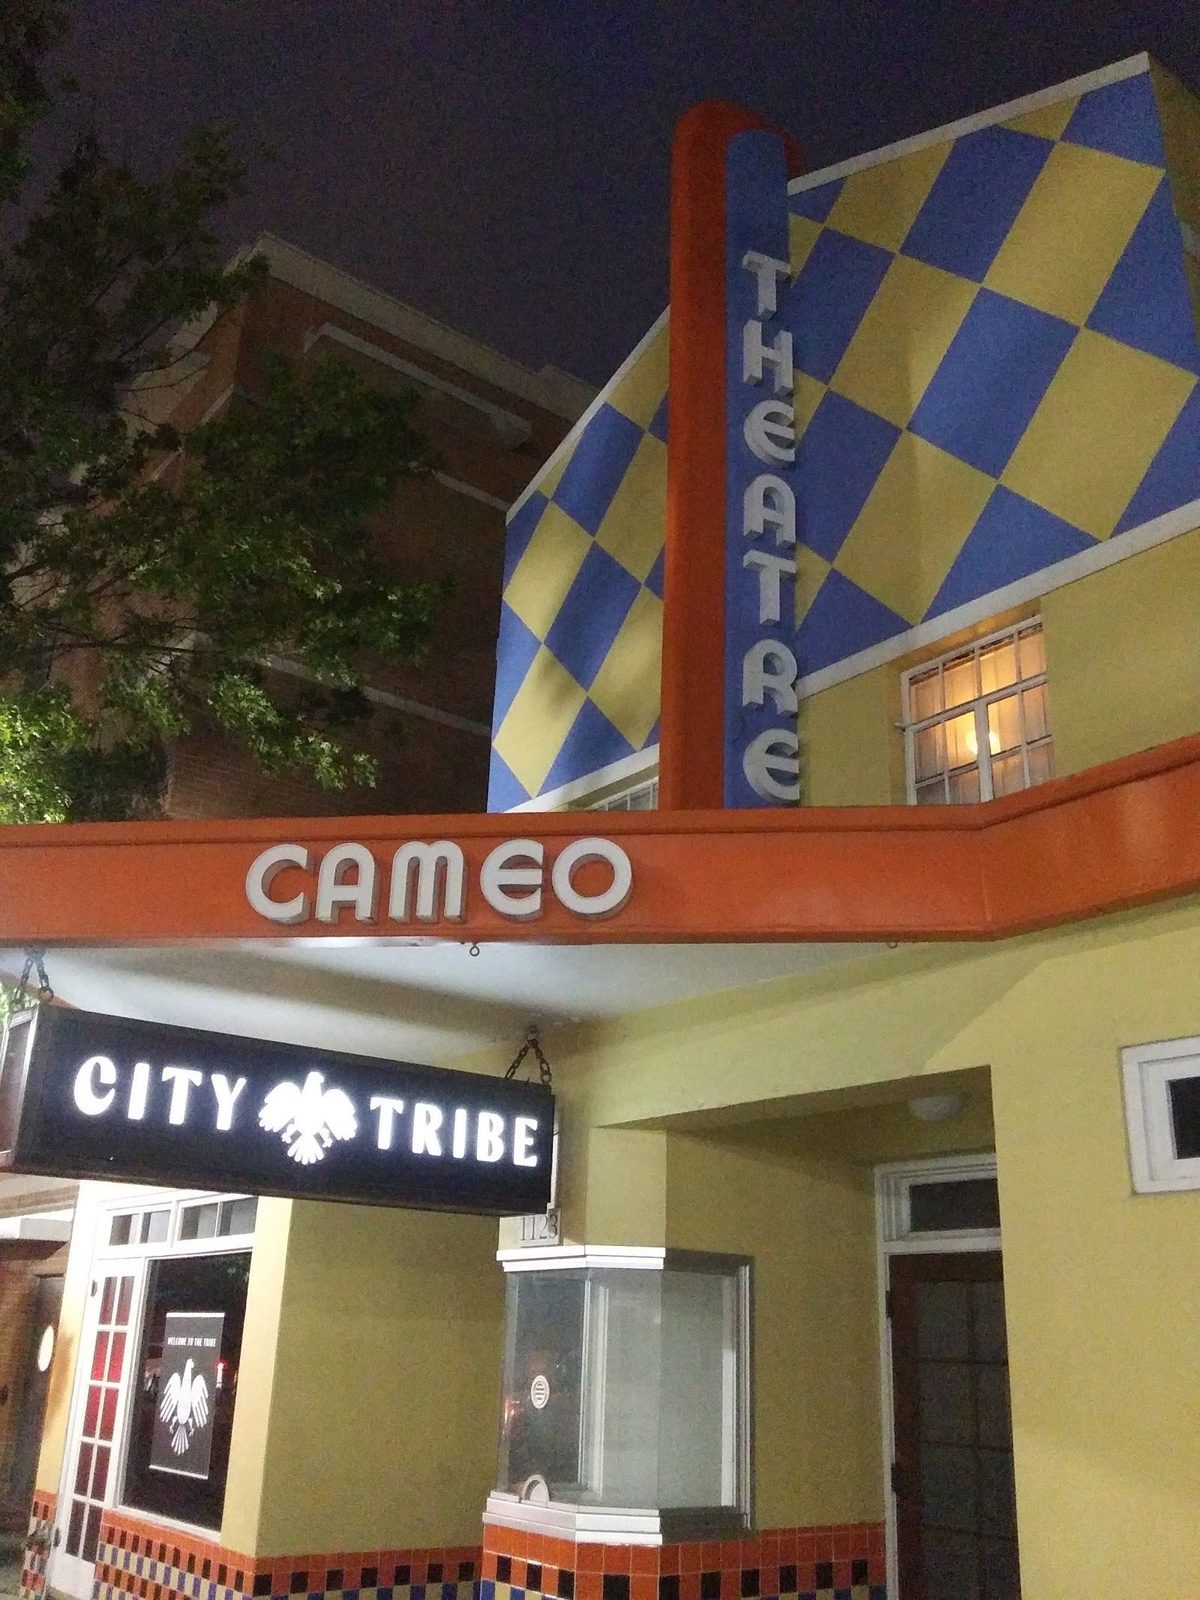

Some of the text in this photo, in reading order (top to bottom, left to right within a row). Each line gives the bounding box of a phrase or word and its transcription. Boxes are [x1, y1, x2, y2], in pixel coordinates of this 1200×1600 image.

[742, 250, 800, 802] THEATRE
[245, 837, 633, 925] CAMEO
[73, 1055, 539, 1168] CITY TRIBE
[520, 1213, 558, 1240] 1123
[168, 1337, 187, 1346] WELCOME
